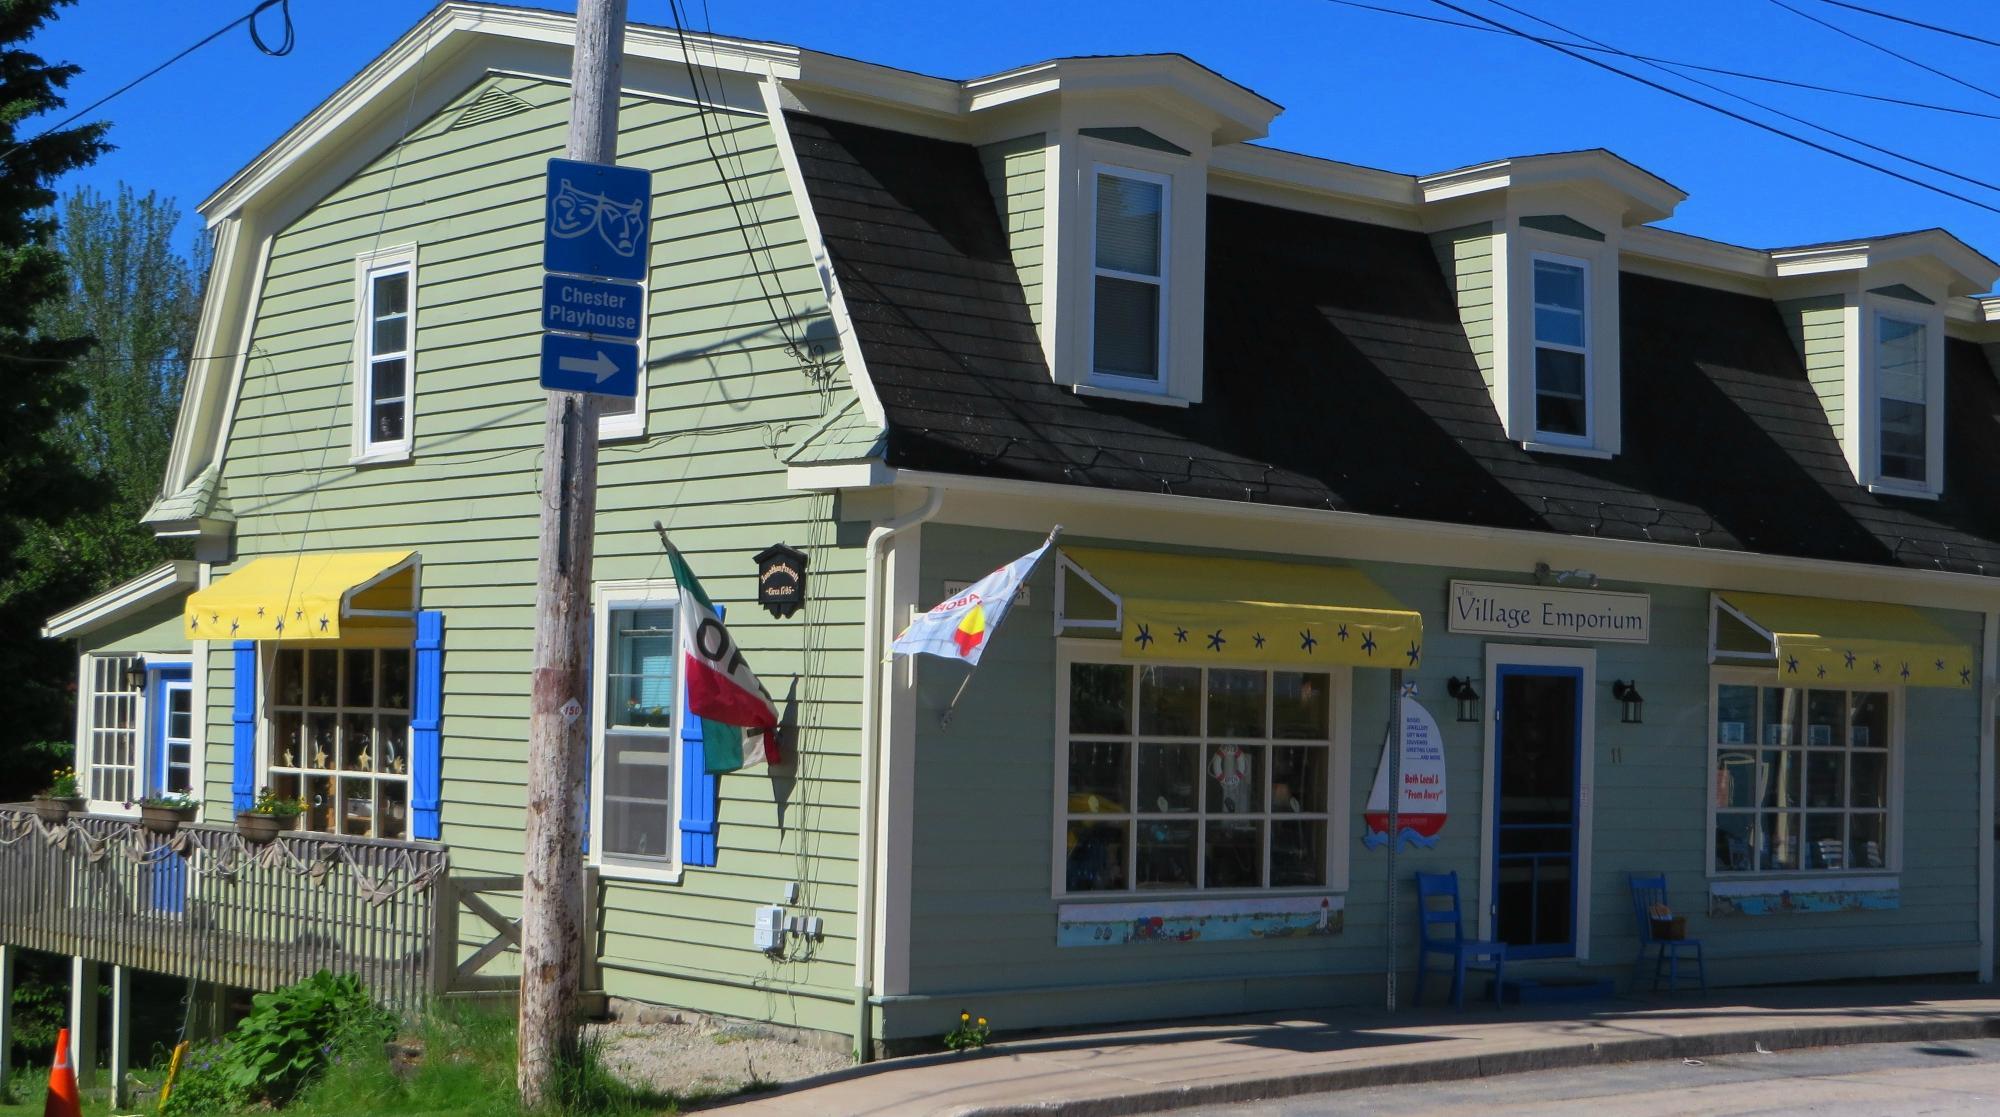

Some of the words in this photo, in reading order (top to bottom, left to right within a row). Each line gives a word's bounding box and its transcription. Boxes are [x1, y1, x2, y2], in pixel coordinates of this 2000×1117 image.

[561, 286, 626, 309] Chester
[550, 305, 636, 330] Playhouse
[1460, 586, 1474, 597] The
[1457, 596, 1531, 628] Village
[1542, 602, 1642, 632] Emporium
[565, 706, 580, 716] 150
[1405, 774, 1419, 784] Both
[1420, 774, 1434, 784] Local
